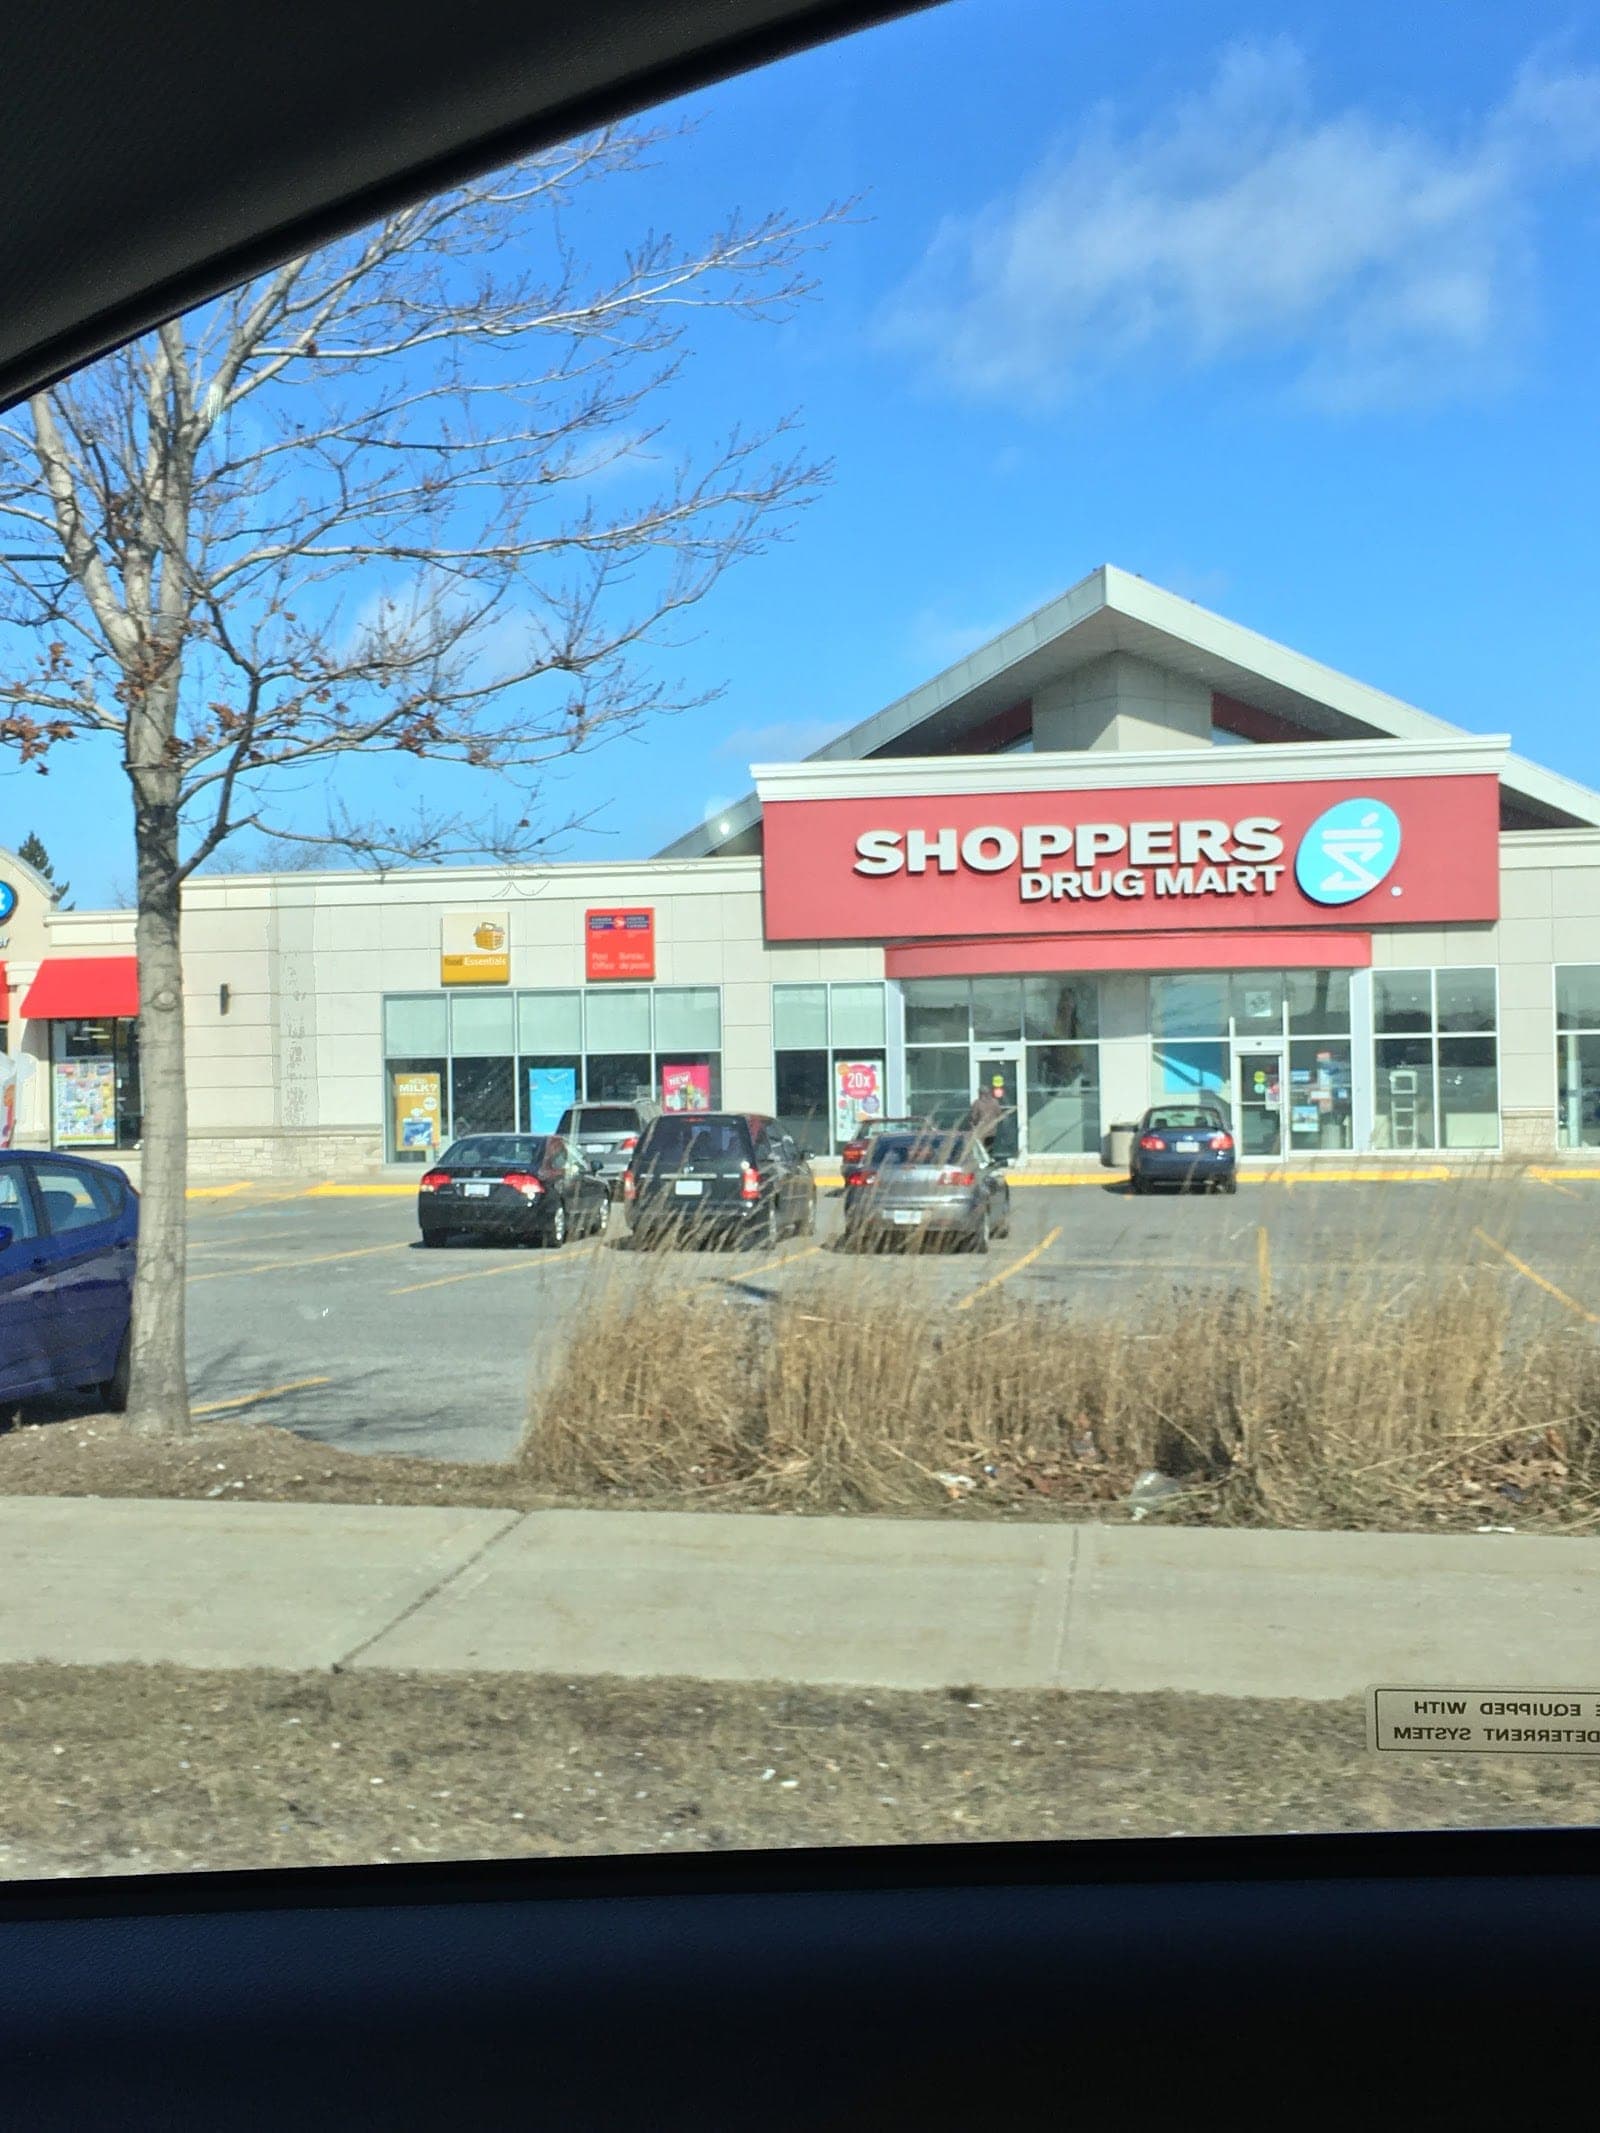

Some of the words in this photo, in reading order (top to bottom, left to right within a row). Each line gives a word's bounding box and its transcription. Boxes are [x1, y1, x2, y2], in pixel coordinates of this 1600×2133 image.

[853, 816, 1285, 875] SHOPPERS
[1020, 868, 1146, 900] DRUG
[1155, 864, 1286, 896] MART
[463, 956, 507, 967] Essentials
